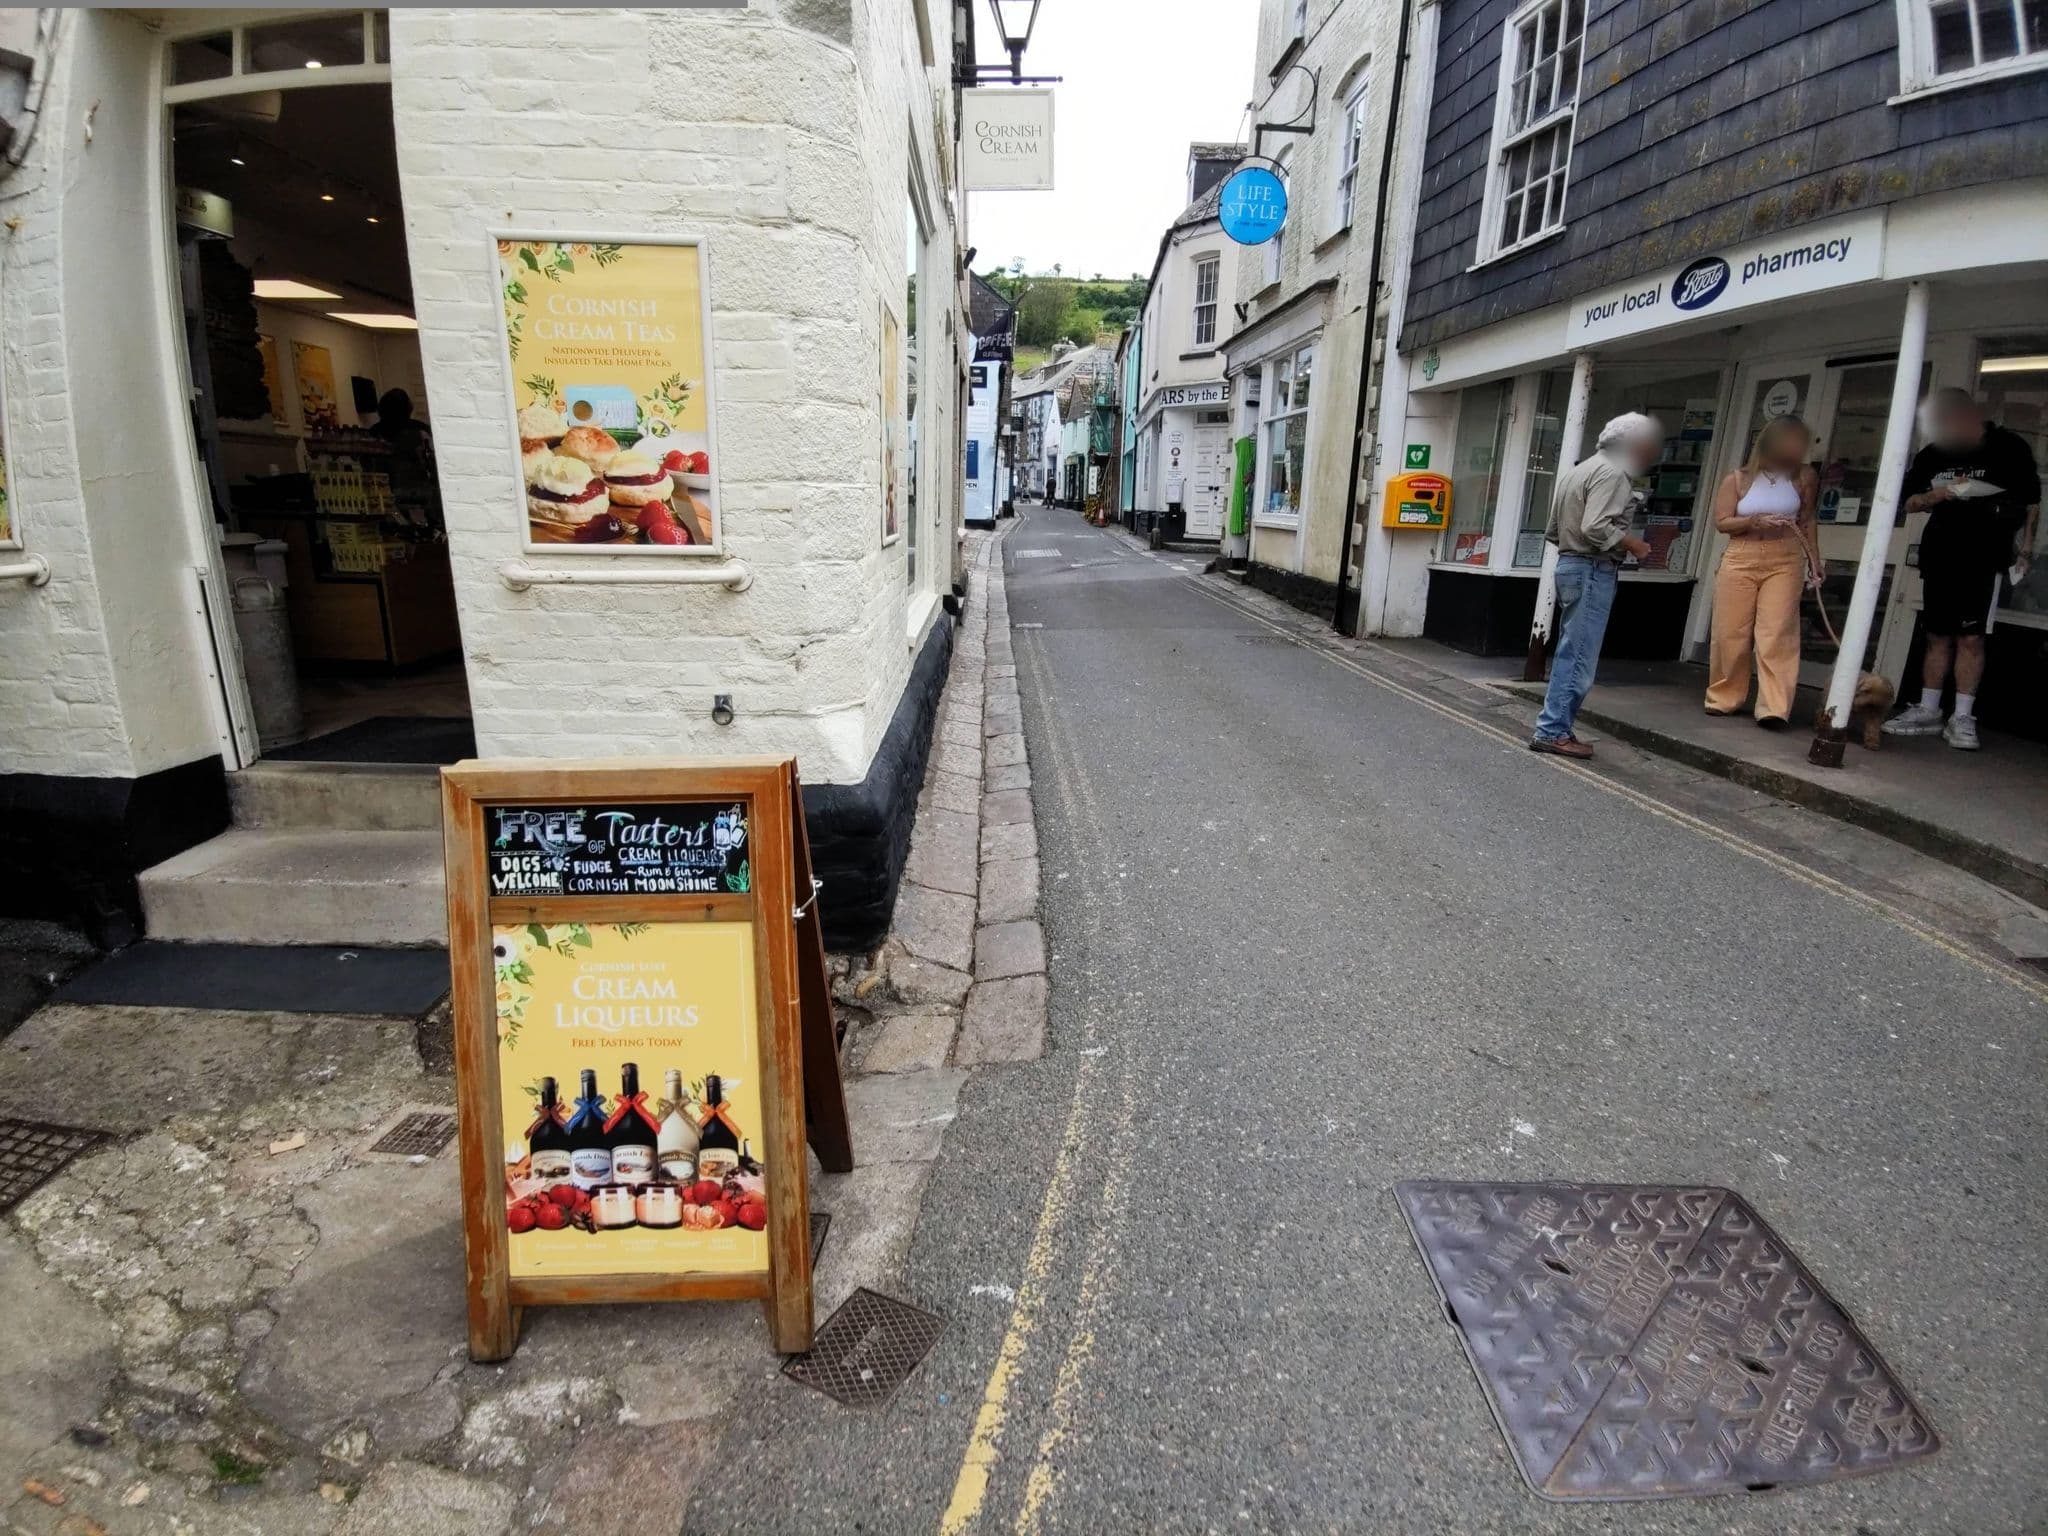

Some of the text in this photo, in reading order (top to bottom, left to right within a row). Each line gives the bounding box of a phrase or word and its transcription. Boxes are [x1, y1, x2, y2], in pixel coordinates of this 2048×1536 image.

[976, 121, 1042, 137] CORNISH
[980, 138, 1038, 153] CREAM
[1239, 185, 1272, 201] LIFE
[1227, 202, 1279, 219] STYLE
[1584, 236, 1852, 328] your local Boots pharmacy
[548, 294, 657, 318] CORNISH
[534, 321, 677, 342] CREAM TEAS
[978, 332, 1012, 350] COFFEE
[552, 346, 661, 357] NATIONWIDE DELIVERY &
[544, 357, 672, 368] INSULATED TAKE HOME PACKS
[1188, 391, 1200, 403] by
[1202, 389, 1218, 401] the
[500, 811, 588, 849] FREE
[594, 811, 706, 847] Tasters
[619, 847, 728, 864] CREAM LIQUEURS
[501, 856, 541, 873] DOGS
[574, 860, 613, 875] FUDGE
[492, 872, 560, 891] WELCOME
[568, 876, 718, 892] CORNISH MOONSHINE
[572, 975, 677, 1000] CREAM
[554, 1004, 700, 1033] LIQUEURS
[572, 1038, 684, 1048] FREE TASTING TODAY
[1758, 1360, 1828, 1465] CHIEFTAIN
